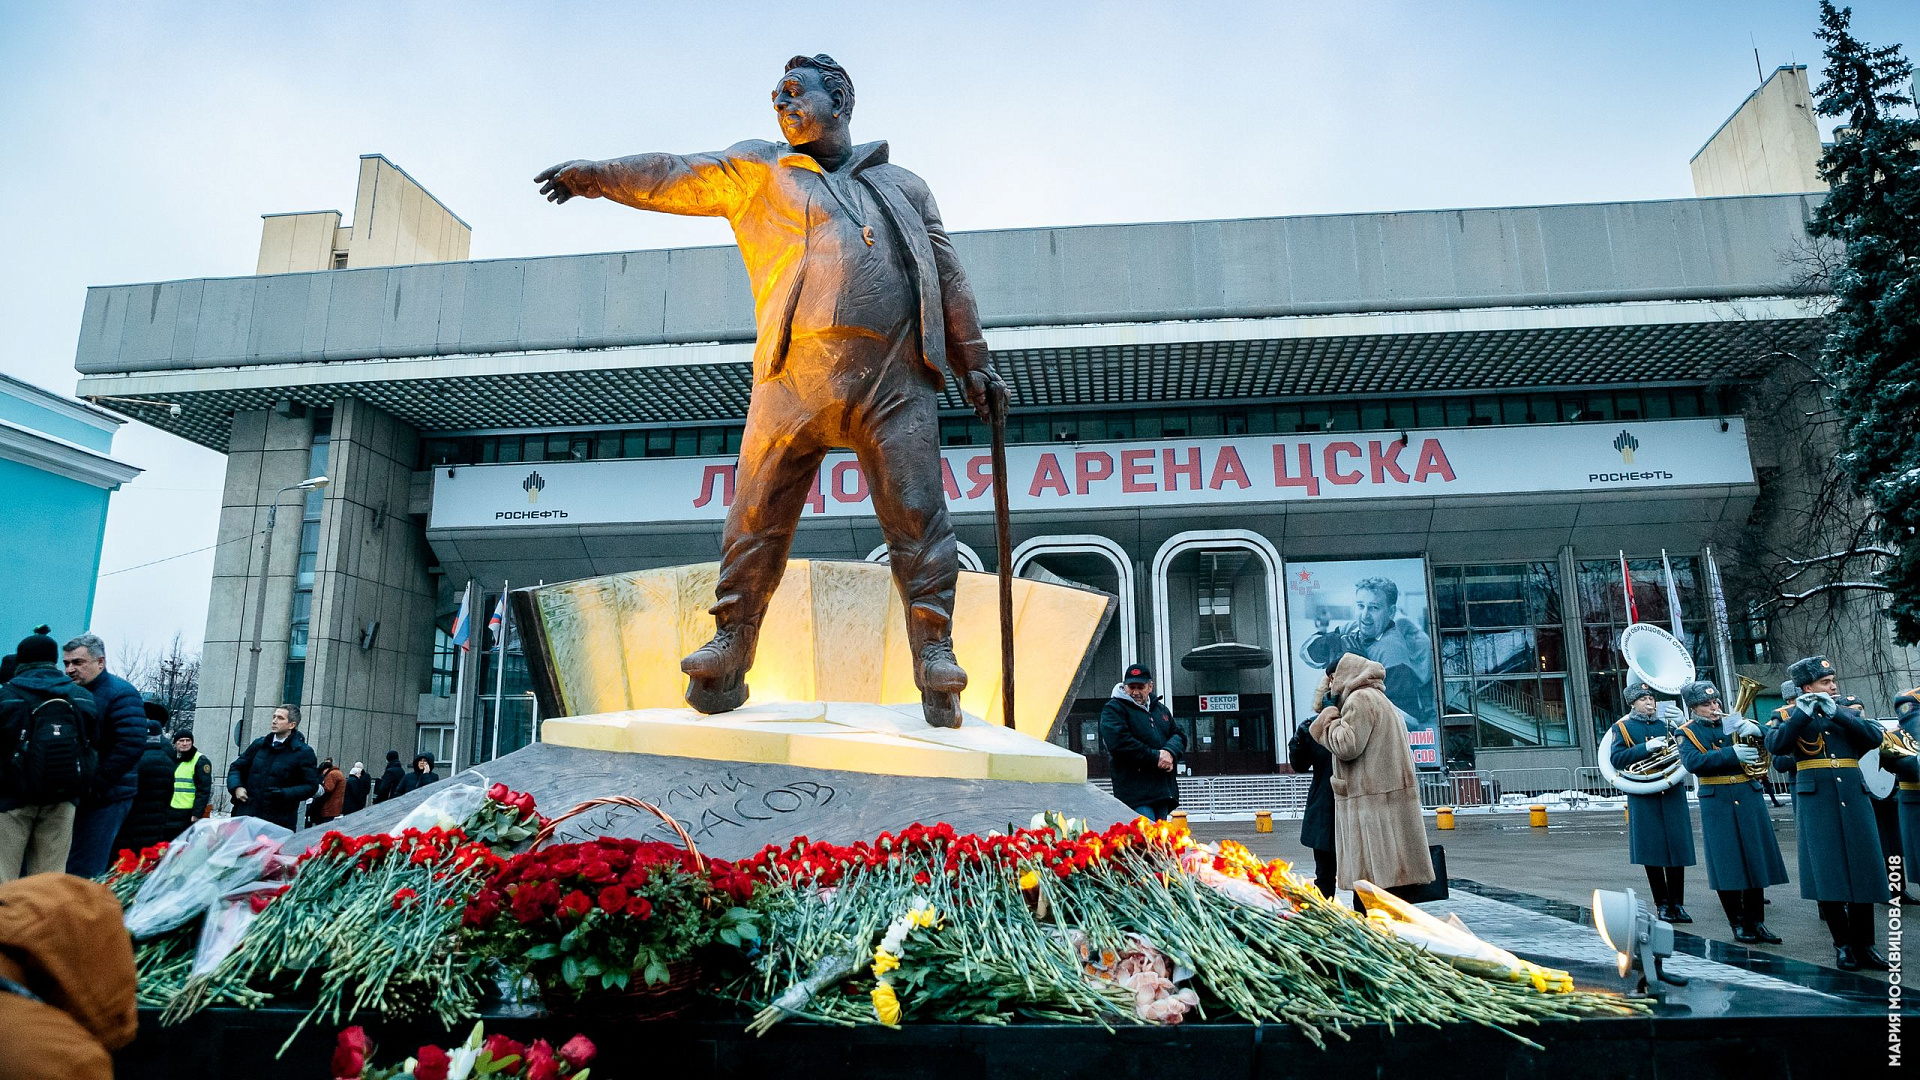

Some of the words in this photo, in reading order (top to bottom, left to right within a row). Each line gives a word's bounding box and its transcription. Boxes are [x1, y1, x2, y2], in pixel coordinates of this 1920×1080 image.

[1028, 444, 1252, 498] АРЕНА
[1272, 438, 1457, 497] ЦСКА
[1589, 471, 1673, 482] РОСНЕФТЬ
[495, 510, 568, 520] РОСНЕФТЬ
[1672, 640, 1692, 668] ОРКЕСТР
[1200, 697, 1208, 710] 5
